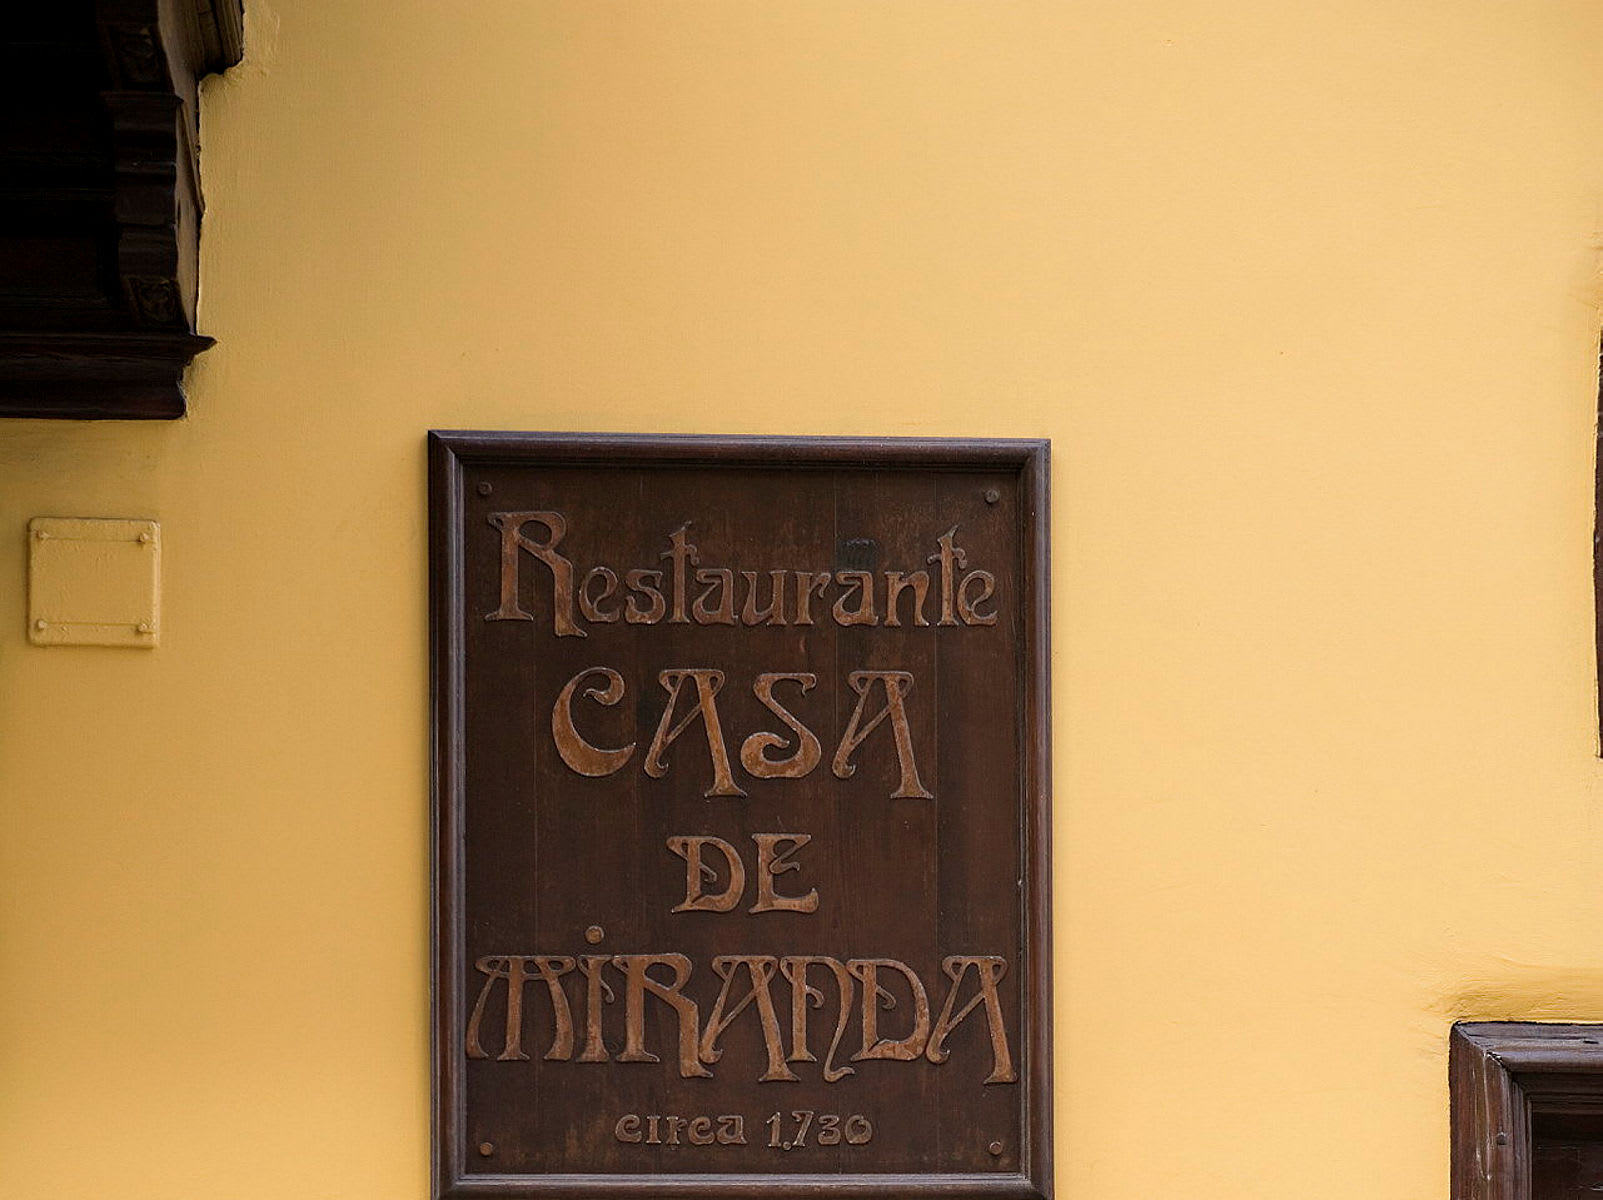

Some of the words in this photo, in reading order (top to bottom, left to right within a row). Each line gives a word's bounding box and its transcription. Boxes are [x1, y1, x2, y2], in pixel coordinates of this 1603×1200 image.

[485, 510, 1000, 638] Restaurante
[551, 667, 934, 799] CASA
[665, 832, 820, 914] DE
